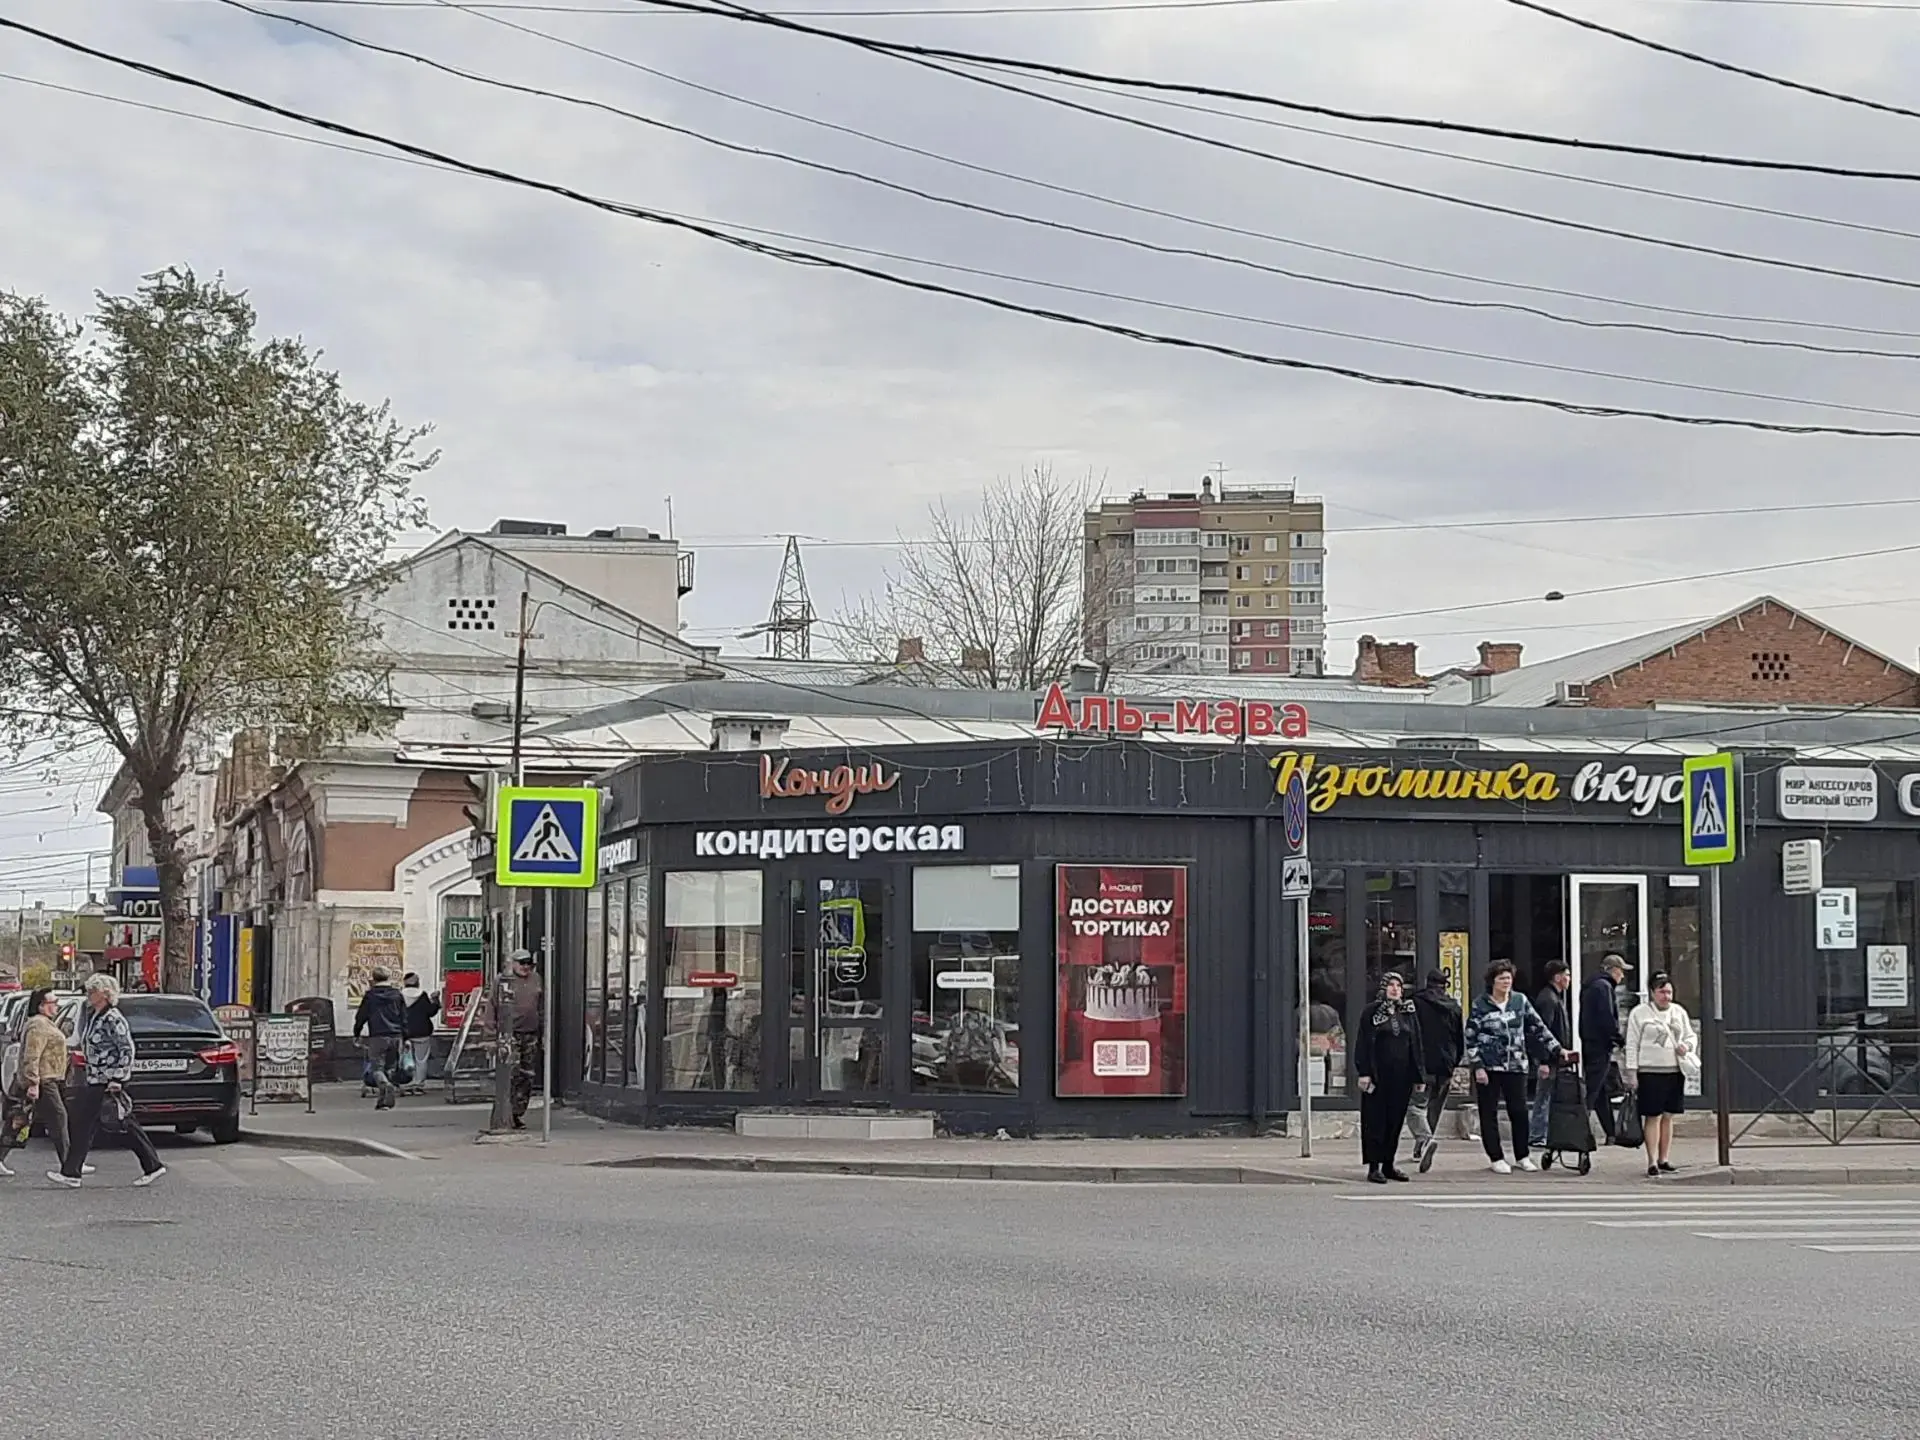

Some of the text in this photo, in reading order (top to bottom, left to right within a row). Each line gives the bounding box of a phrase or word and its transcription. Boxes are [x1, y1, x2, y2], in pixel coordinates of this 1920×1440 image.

[1035, 682, 1309, 739] Аль-мава
[760, 753, 900, 815] Конди
[1269, 750, 1684, 816] Изюминка вкус
[1785, 780, 1872, 791] МИР АКСЕССУАРОВ
[1785, 795, 1873, 806] СЕРВИСНЫЙ ЦЕНТР
[695, 824, 964, 859] кондитерская
[123, 900, 162, 916] ПОТ
[1069, 899, 1173, 916] ДОСТАВКУ
[1072, 920, 1170, 936] ТОРТИКА?
